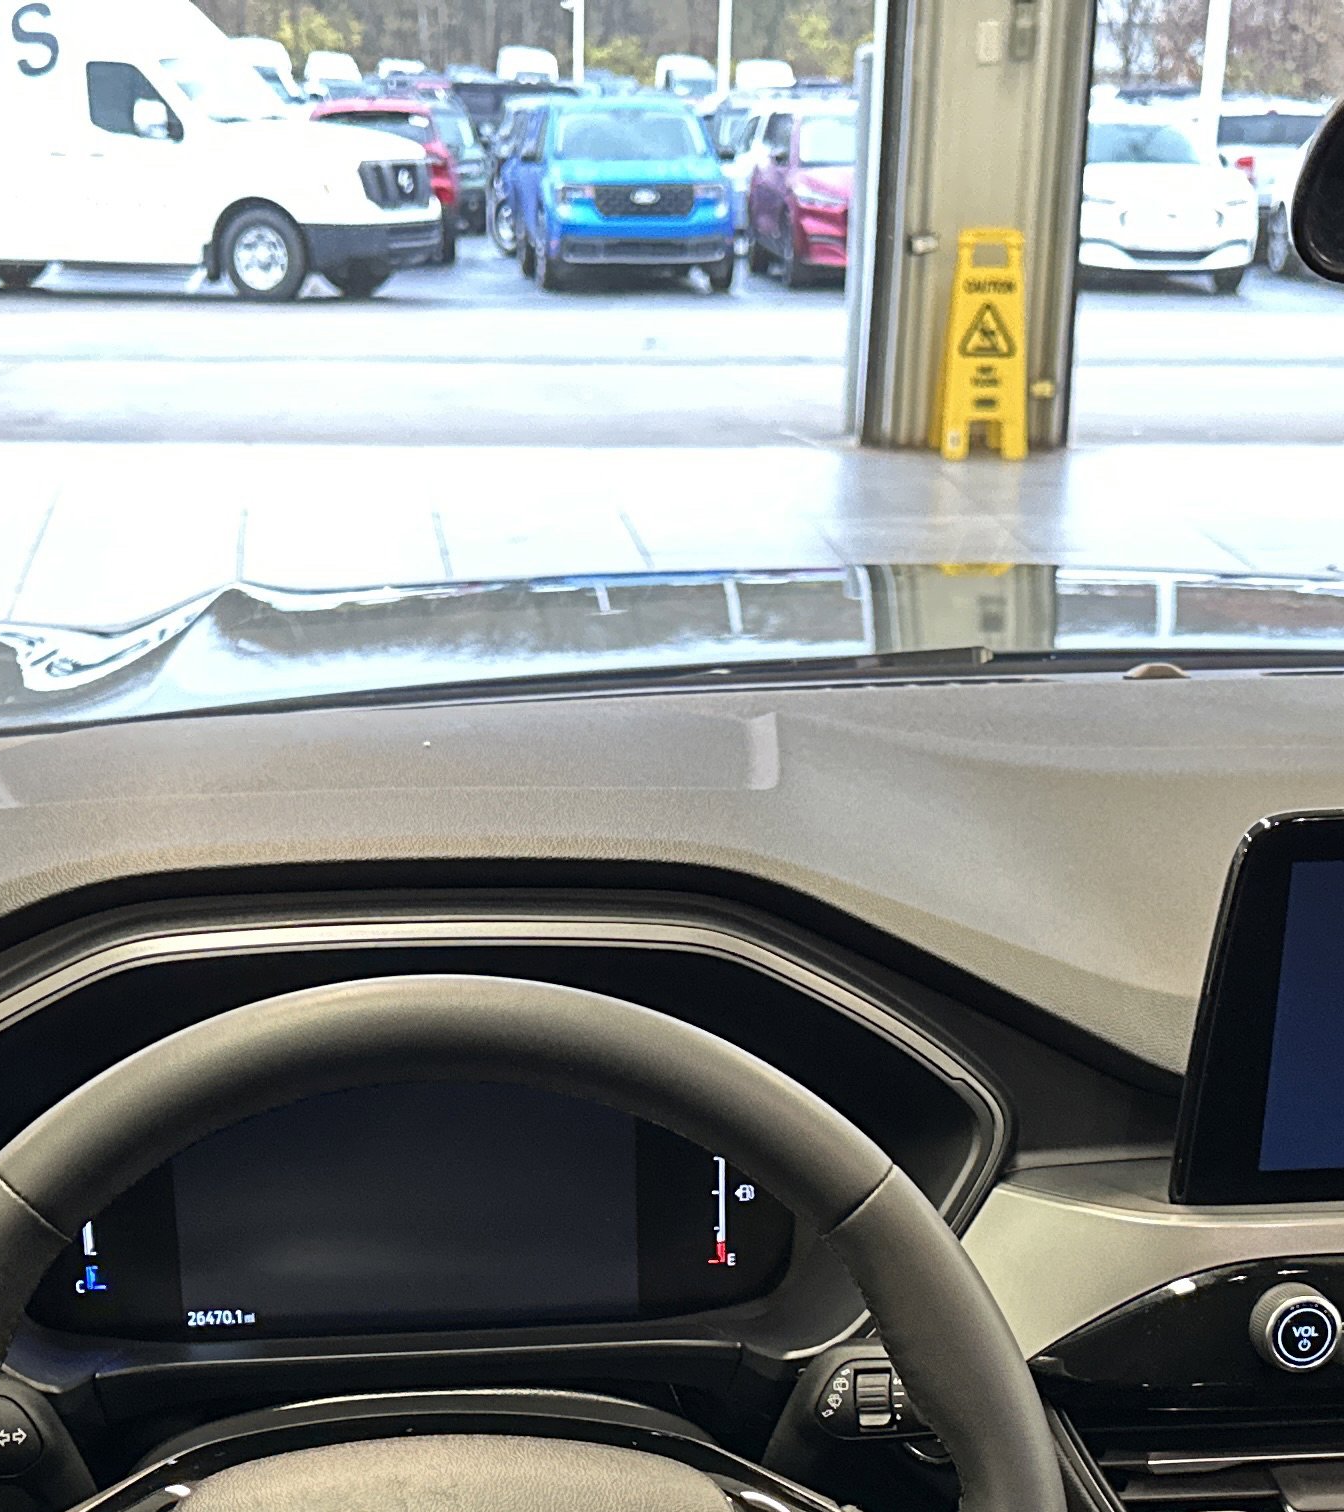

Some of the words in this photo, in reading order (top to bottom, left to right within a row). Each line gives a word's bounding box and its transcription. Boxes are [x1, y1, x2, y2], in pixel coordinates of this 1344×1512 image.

[727, 1253, 736, 1266] E
[76, 1280, 85, 1293] C
[187, 1310, 243, 1326] 26470.1
[1292, 1326, 1319, 1337] VOL
